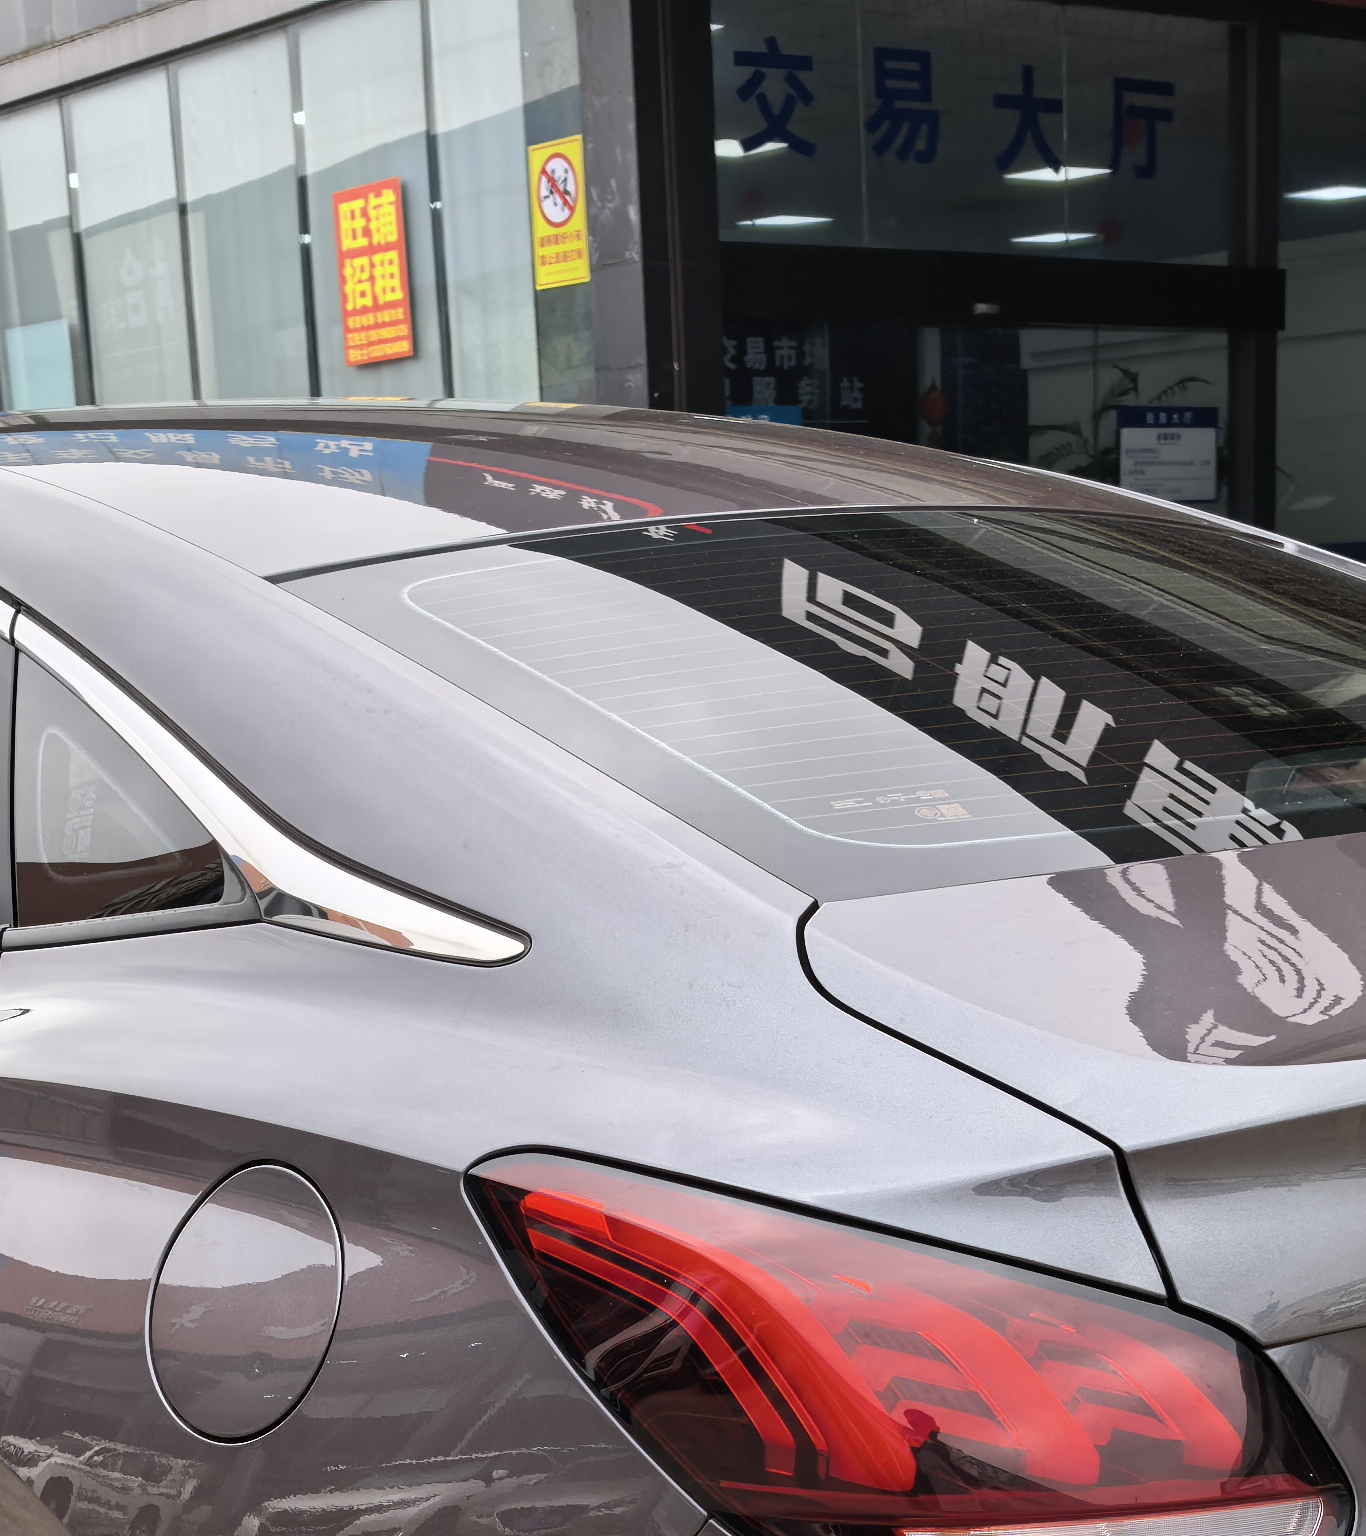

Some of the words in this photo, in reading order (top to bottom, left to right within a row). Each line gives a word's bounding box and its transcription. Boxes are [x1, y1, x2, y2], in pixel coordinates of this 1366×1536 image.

[733, 36, 1175, 180] 交易大厅
[338, 189, 399, 252] 旺铺
[343, 250, 404, 311] 招租
[724, 376, 865, 410] 服务站
